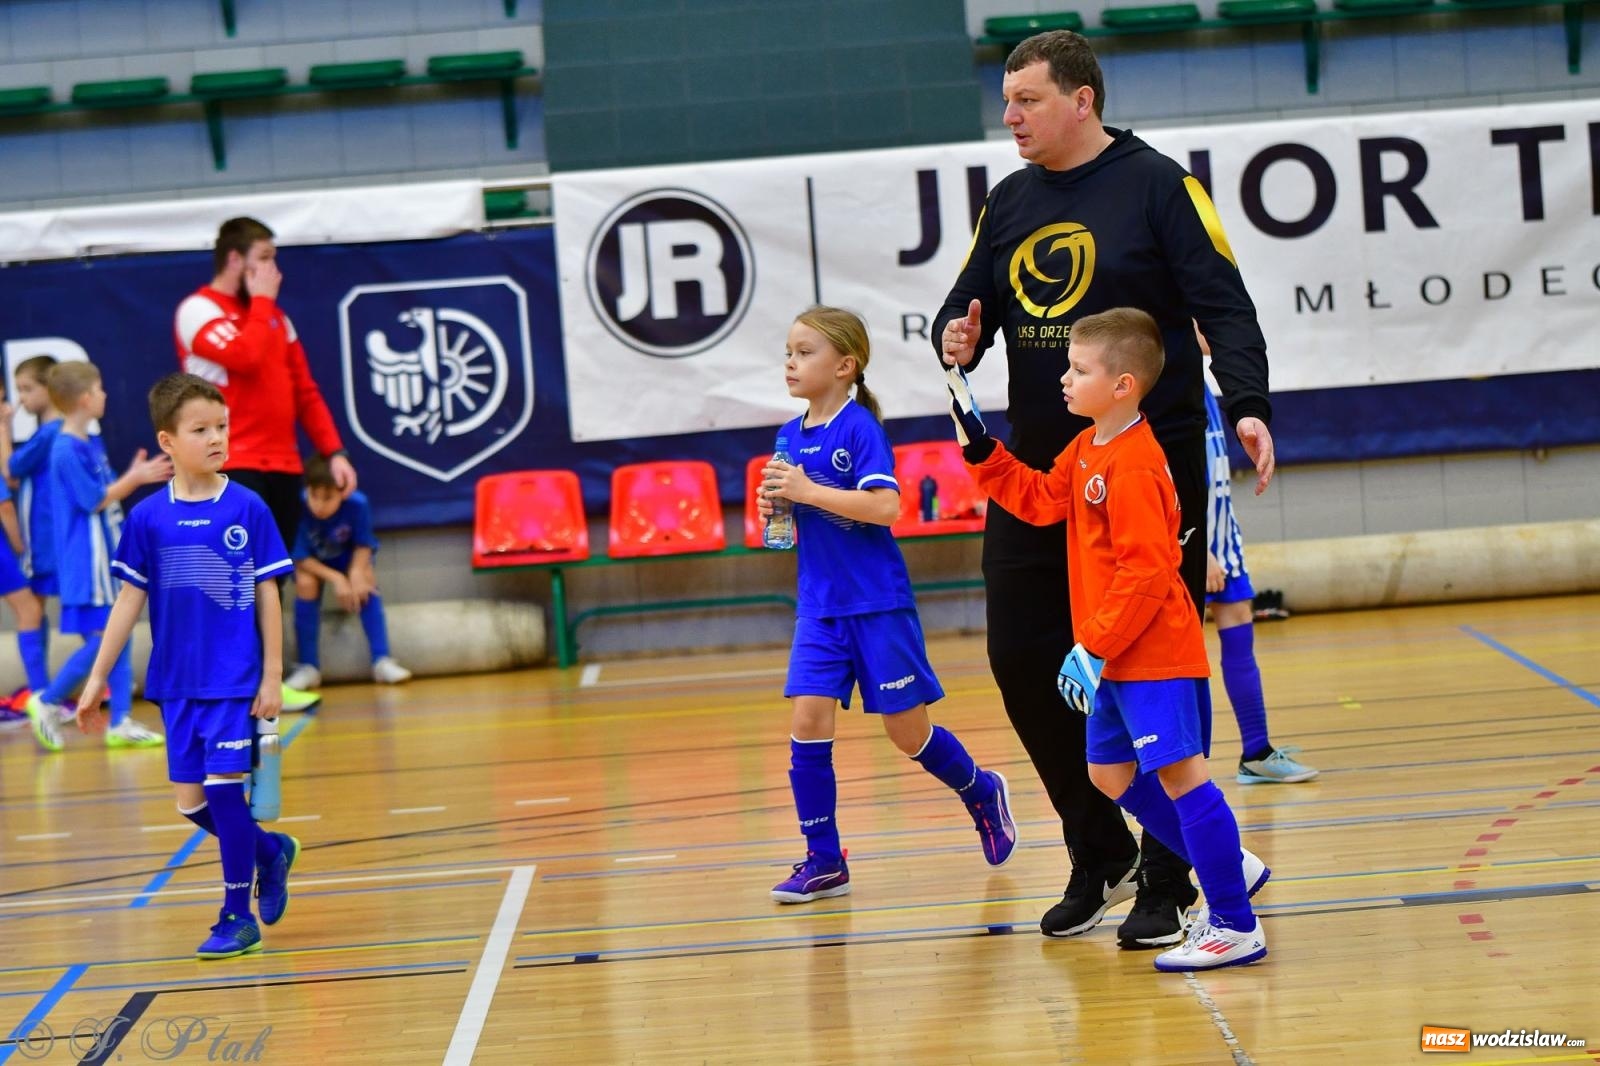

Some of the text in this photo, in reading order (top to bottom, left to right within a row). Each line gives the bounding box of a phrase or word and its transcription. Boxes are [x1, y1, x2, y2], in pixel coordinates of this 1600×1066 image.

[897, 122, 1600, 268] JOR T
[616, 219, 728, 323] JR
[901, 312, 929, 342] R
[1040, 325, 1072, 338] ORZE
[799, 446, 822, 455] regio
[177, 519, 212, 528] regio
[879, 674, 916, 691] regio
